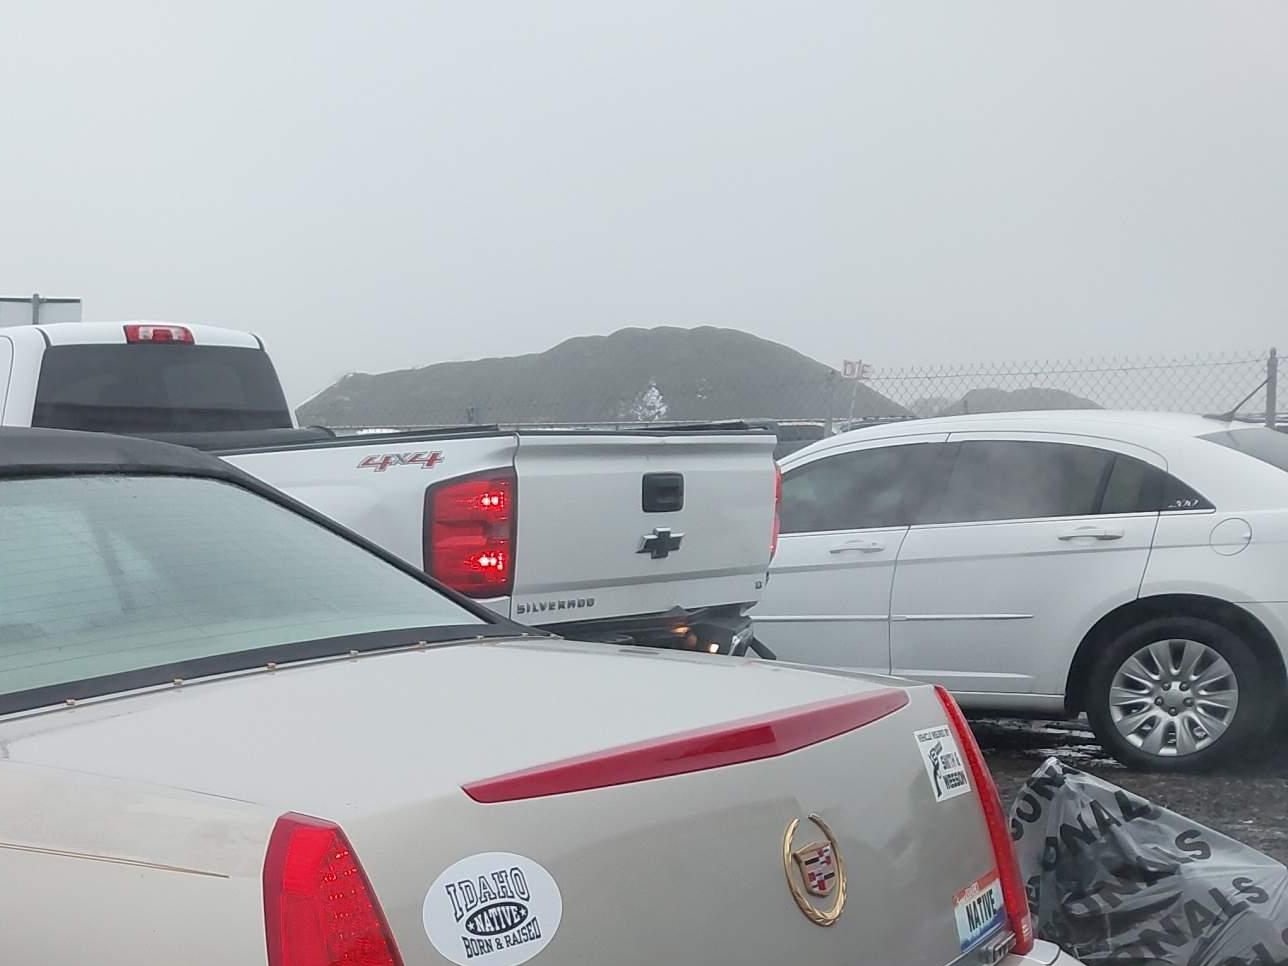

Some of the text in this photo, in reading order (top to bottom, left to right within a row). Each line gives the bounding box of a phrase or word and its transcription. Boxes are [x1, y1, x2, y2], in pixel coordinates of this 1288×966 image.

[516, 597, 596, 615] SILVERADO
[445, 867, 530, 922] IDAHO
[966, 888, 997, 933] NATIVE
[462, 916, 541, 958] BORN & RAISED
[473, 905, 521, 933] NATIVE
